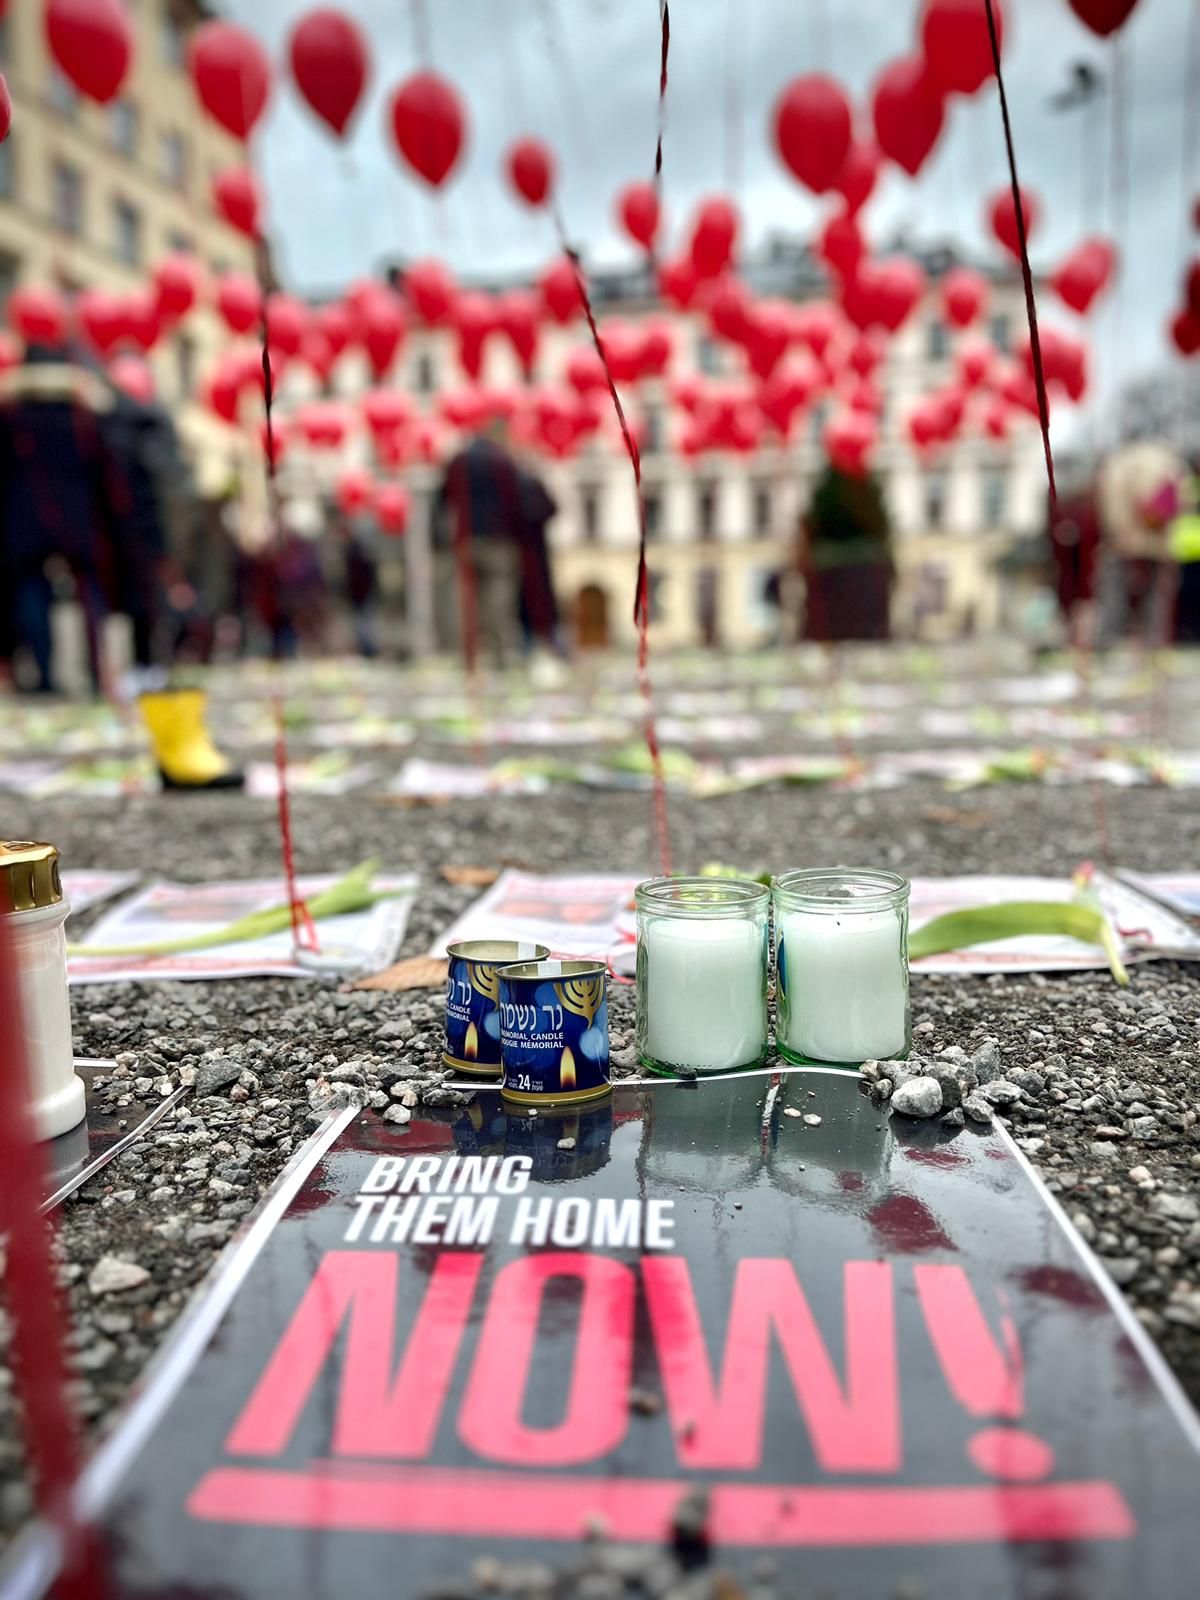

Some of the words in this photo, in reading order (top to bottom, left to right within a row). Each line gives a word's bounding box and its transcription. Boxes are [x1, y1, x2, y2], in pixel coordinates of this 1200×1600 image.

[449, 1003, 471, 1014] CANDLE
[542, 1004, 563, 1030] נר
[520, 1039, 564, 1049] MÉMORIAL
[530, 1032, 564, 1040] CANDLE
[518, 1074, 531, 1090] 24
[360, 1155, 532, 1194] BRING
[343, 1196, 500, 1245] THEM
[509, 1197, 676, 1249] HOME
[225, 1250, 1055, 1479] NOW!
